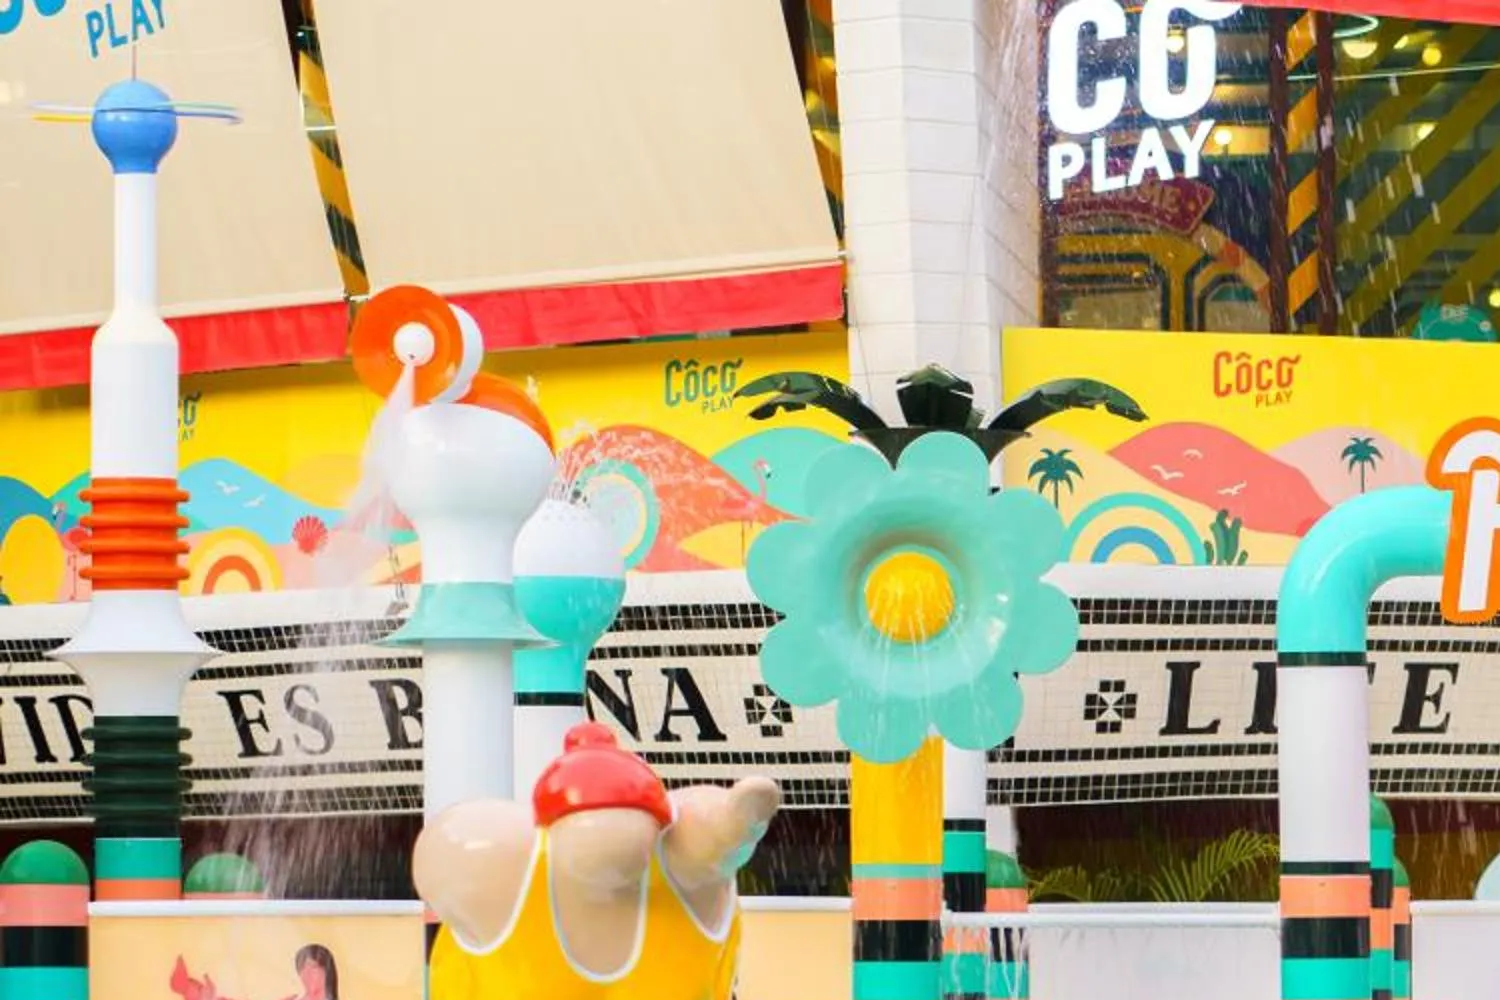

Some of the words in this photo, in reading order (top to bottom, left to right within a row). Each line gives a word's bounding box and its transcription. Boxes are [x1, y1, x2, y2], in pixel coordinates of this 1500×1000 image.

[1048, 119, 1215, 200] PLAY
[702, 396, 733, 414] PLAY
[1255, 390, 1293, 408] PLAY
[217, 684, 335, 758] ES
[369, 666, 728, 751] BNA
[1159, 661, 1460, 735] LIE
